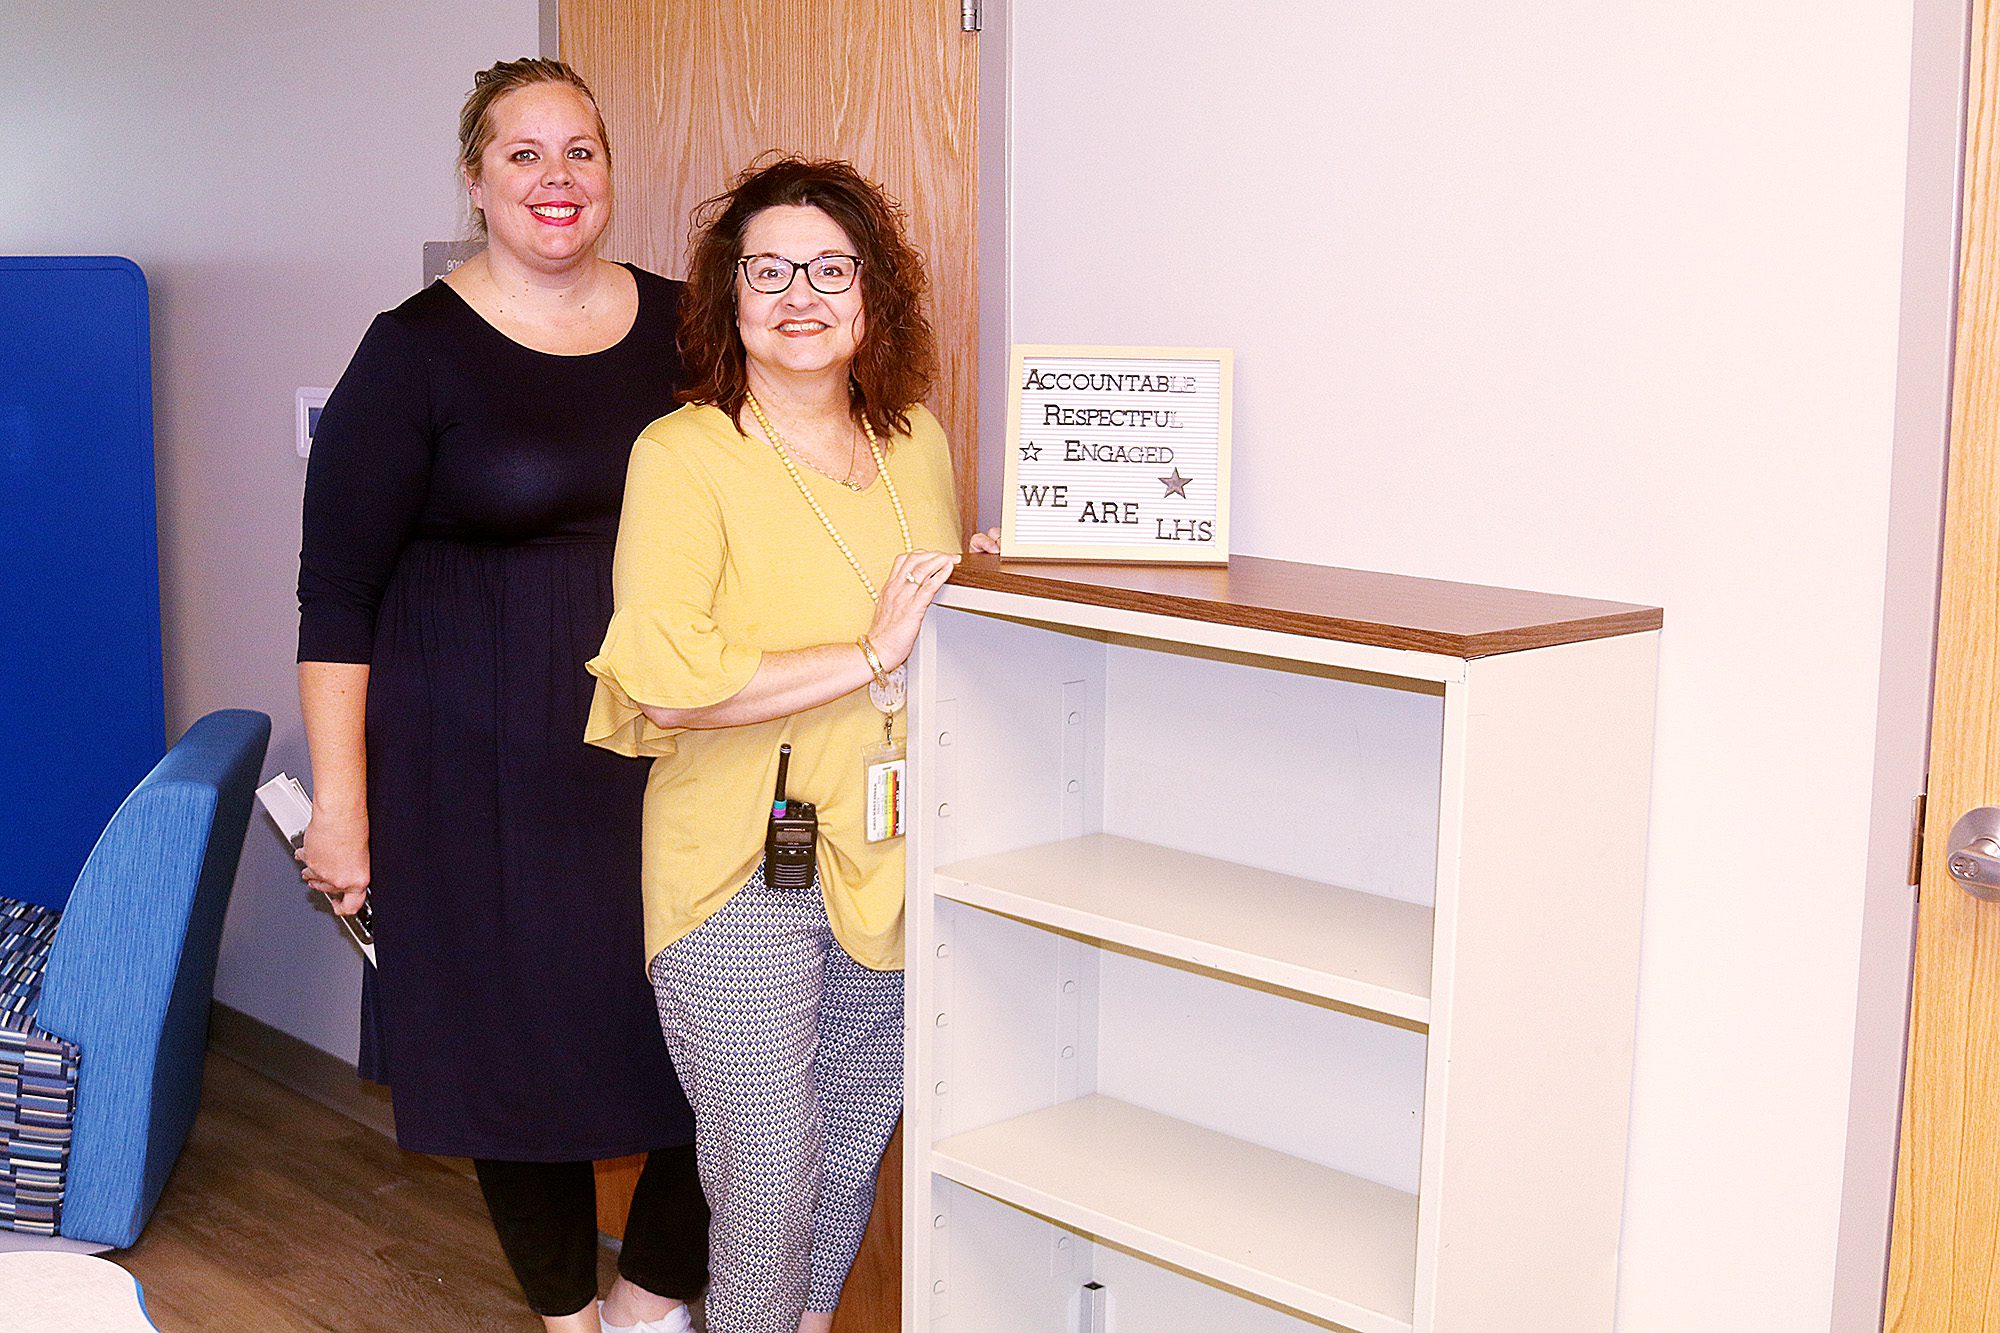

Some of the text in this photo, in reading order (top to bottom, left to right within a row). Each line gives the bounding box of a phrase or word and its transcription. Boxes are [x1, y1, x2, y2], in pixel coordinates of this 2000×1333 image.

[1022, 368, 1196, 394] ACCOUNTABLE
[1043, 404, 1184, 428] RESPECTFUL
[1064, 440, 1174, 464] ENGAGED
[1020, 485, 1213, 542] WE ARE LHS
